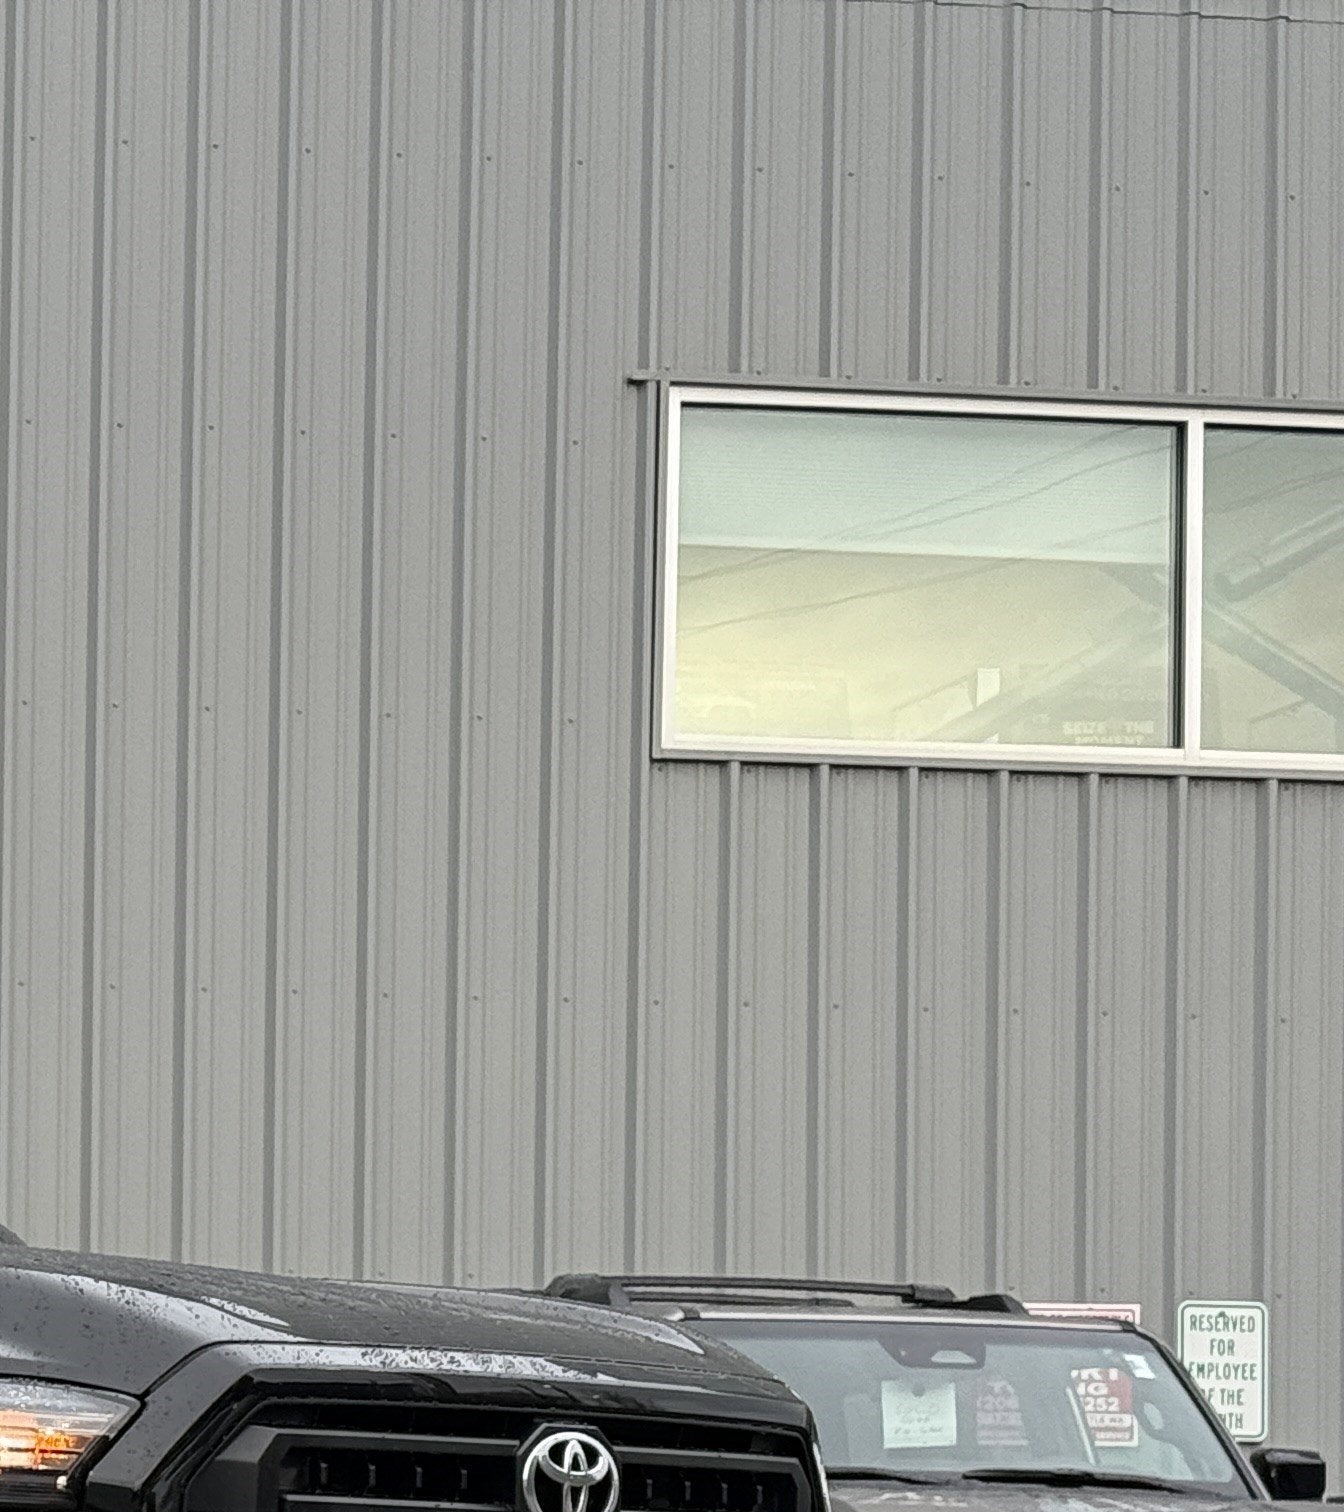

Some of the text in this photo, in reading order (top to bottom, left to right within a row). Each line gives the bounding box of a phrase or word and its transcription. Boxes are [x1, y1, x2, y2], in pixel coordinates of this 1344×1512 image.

[1189, 1314, 1256, 1334] RESERVED
[1209, 1338, 1235, 1356] FOR
[1188, 1362, 1258, 1381] EMPLOYEE
[1219, 1387, 1245, 1406] THE
